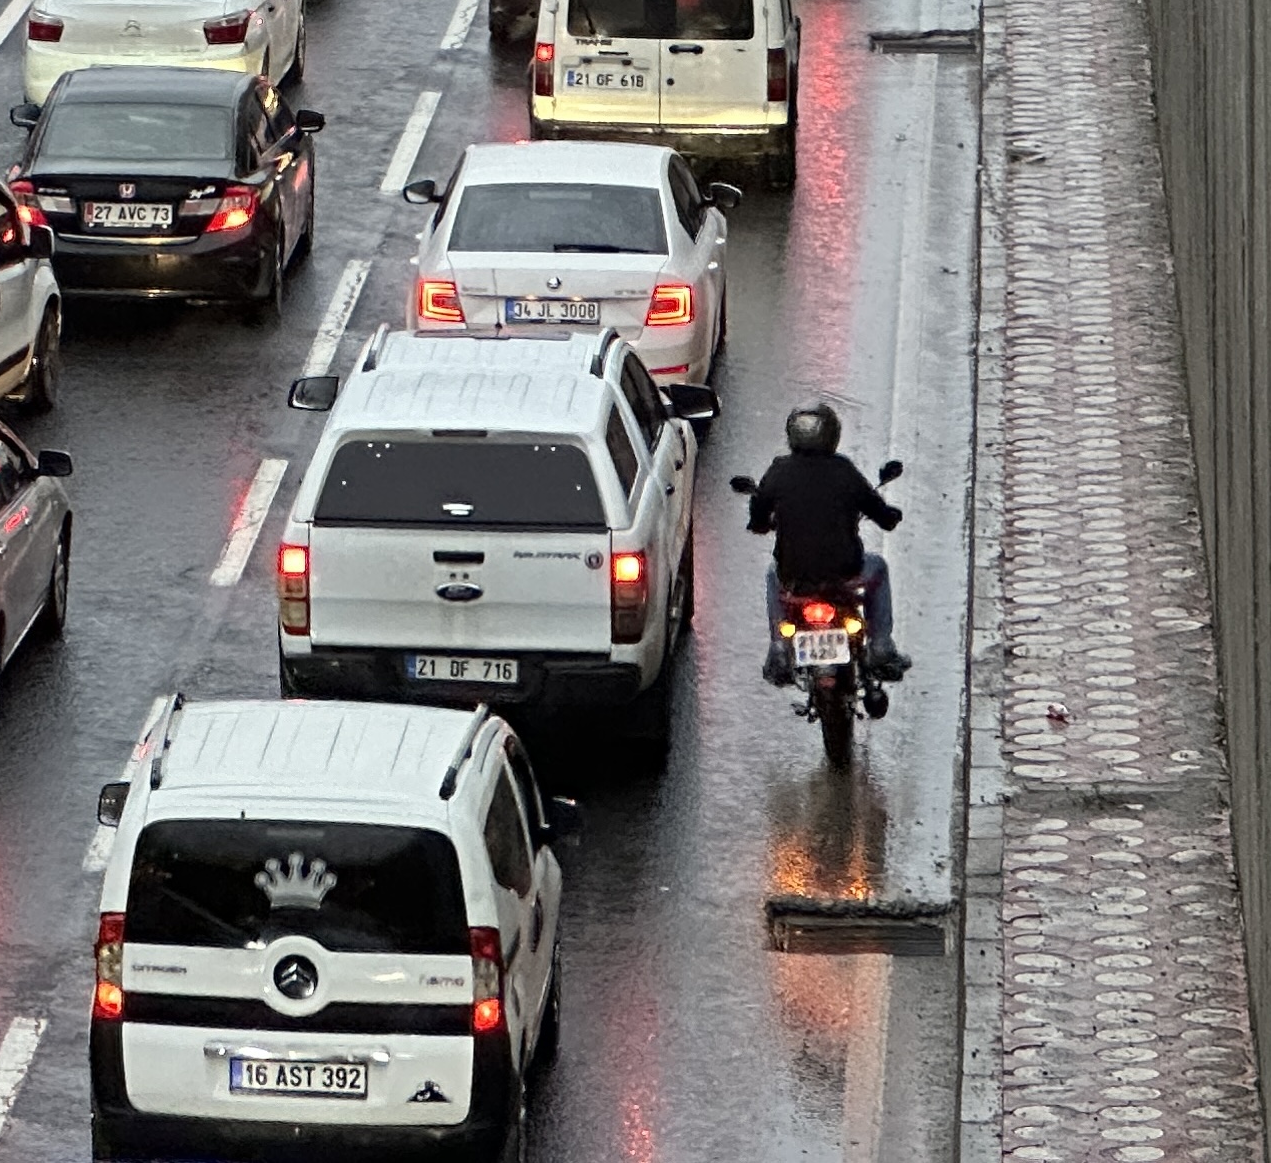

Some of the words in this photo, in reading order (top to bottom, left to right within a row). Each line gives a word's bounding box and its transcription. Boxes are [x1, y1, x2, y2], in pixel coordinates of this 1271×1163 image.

[575, 72, 590, 86] 21
[620, 74, 644, 88] 618
[94, 206, 112, 220] 27
[118, 206, 147, 221] AVC
[151, 207, 169, 221] 73
[514, 302, 532, 318] 34
[537, 303, 553, 318] JL
[560, 303, 596, 319] 3008
[417, 659, 436, 677] 21
[450, 660, 469, 678] DF
[483, 661, 513, 679] 716
[245, 1064, 267, 1086] 16
[275, 1065, 316, 1087] AST
[322, 1067, 362, 1090] 392
